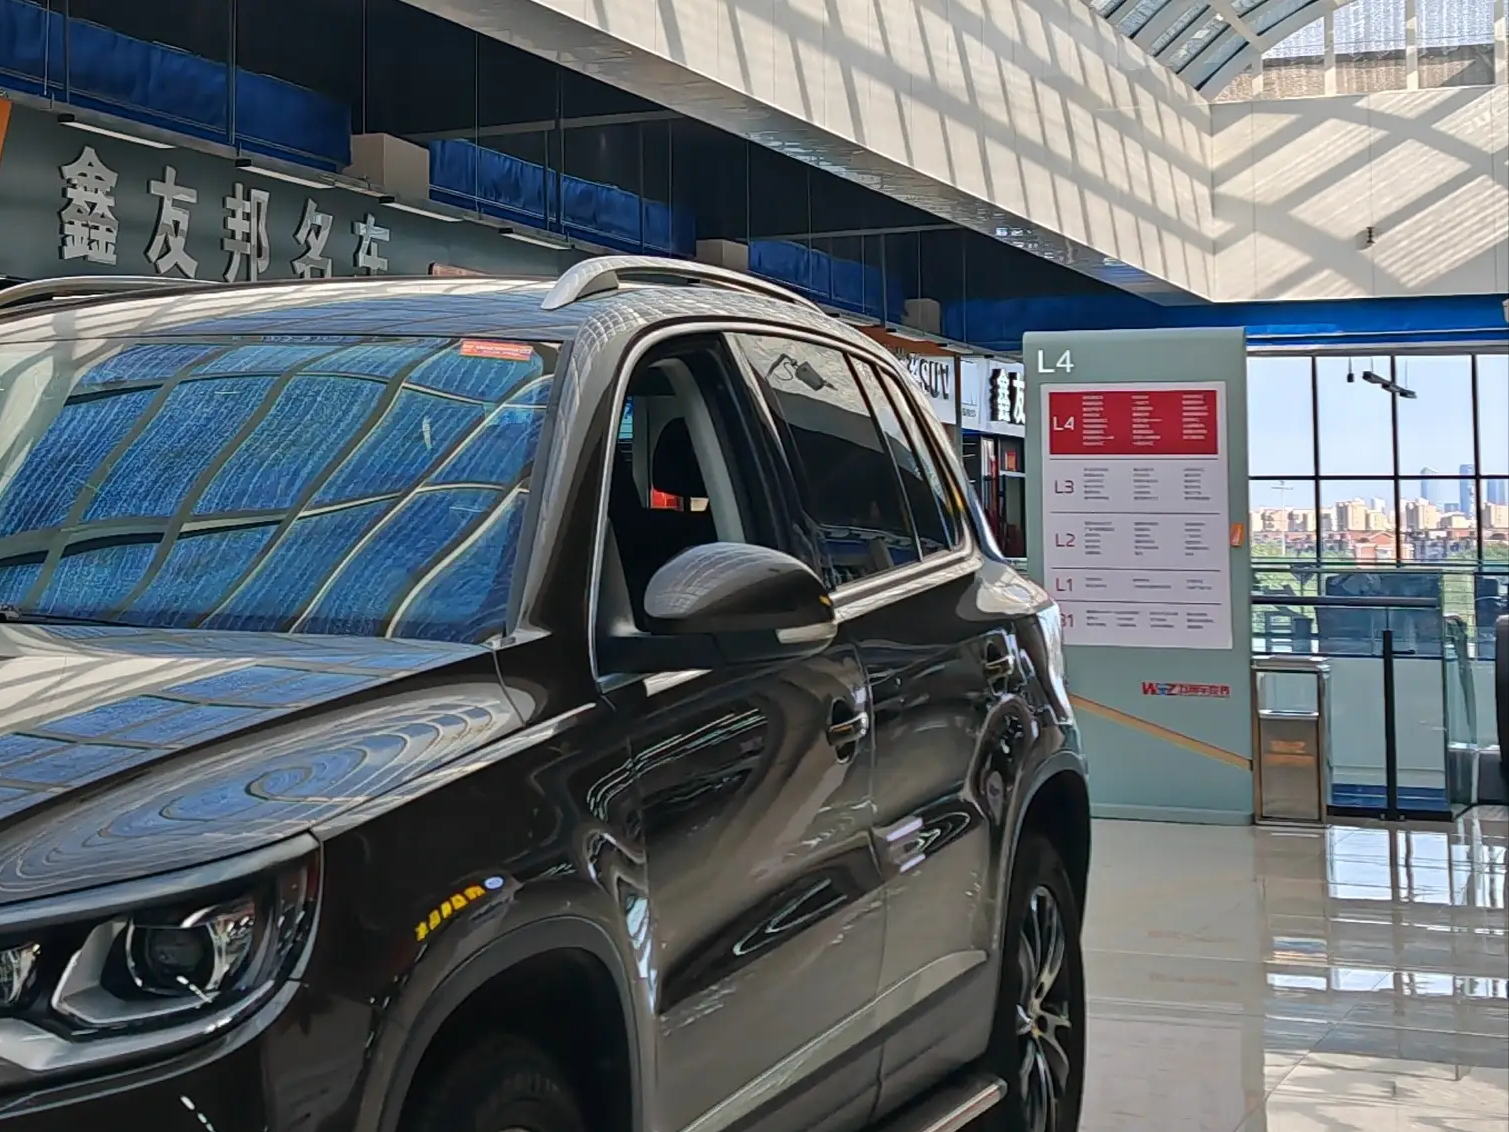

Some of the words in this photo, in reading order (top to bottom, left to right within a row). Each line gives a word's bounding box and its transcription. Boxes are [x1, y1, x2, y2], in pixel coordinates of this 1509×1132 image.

[59, 146, 390, 282] 鑫友邦名车
[1038, 350, 1075, 373] L4
[1053, 417, 1075, 431] L4
[1054, 480, 1075, 494] L3
[1055, 533, 1076, 547] L2
[1056, 578, 1073, 592] L1
